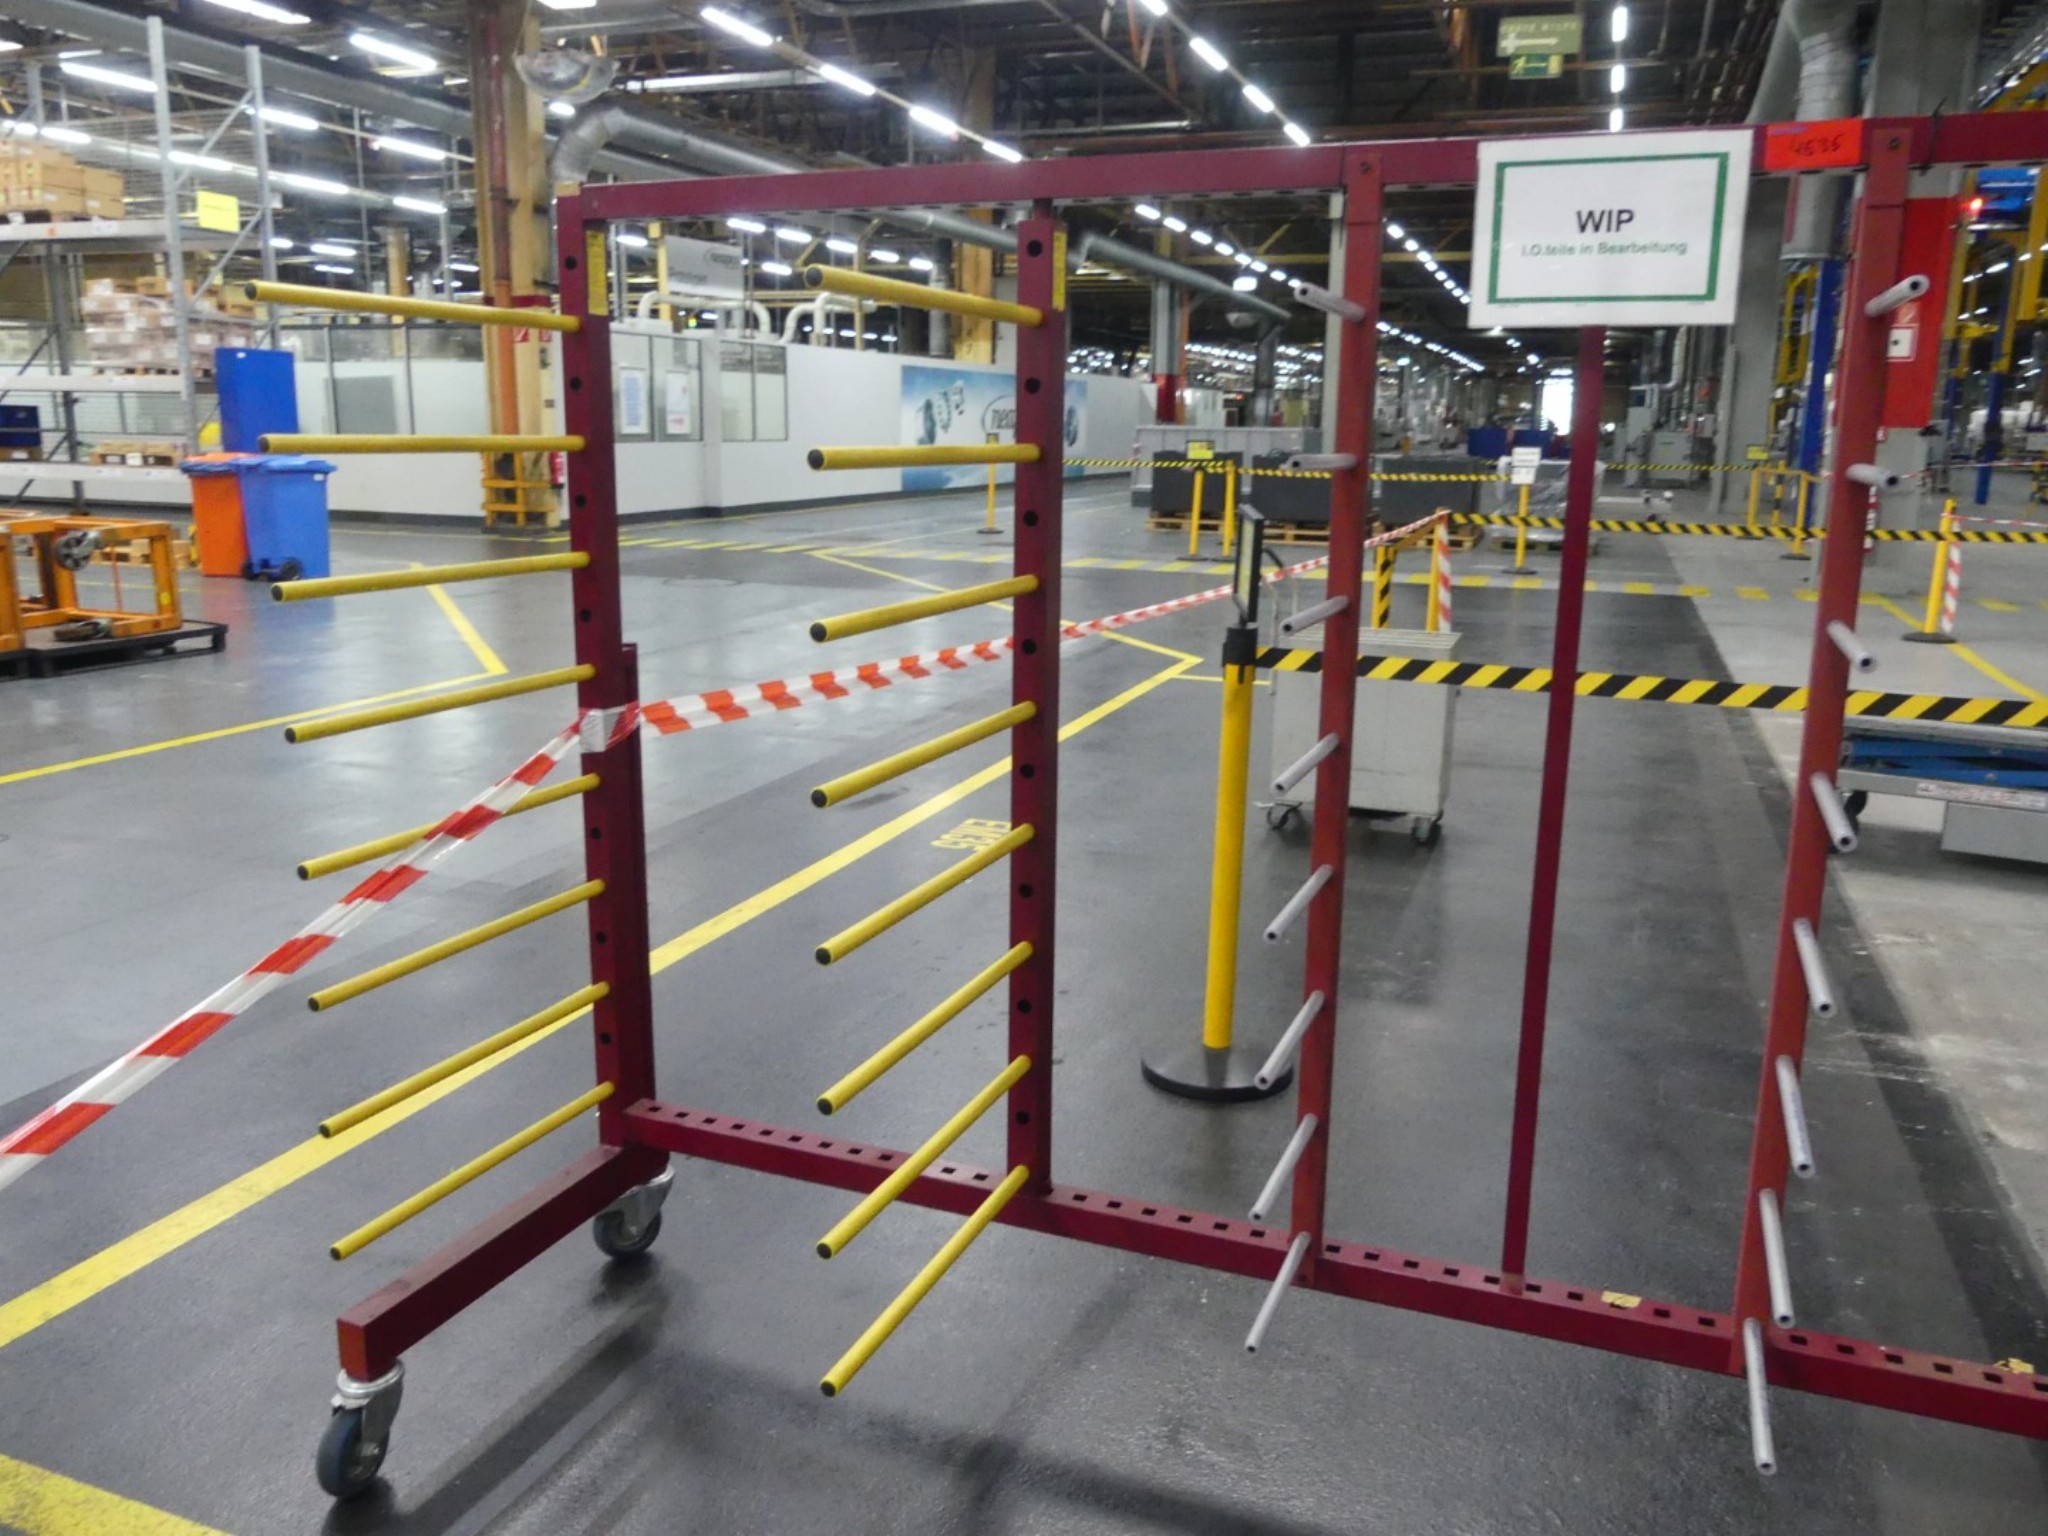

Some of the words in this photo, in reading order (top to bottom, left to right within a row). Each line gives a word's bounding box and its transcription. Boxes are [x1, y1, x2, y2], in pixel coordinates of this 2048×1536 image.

[1576, 208, 1634, 233] WIP
[1579, 242, 1593, 254] in
[1598, 241, 1688, 256] Bearbeitung
